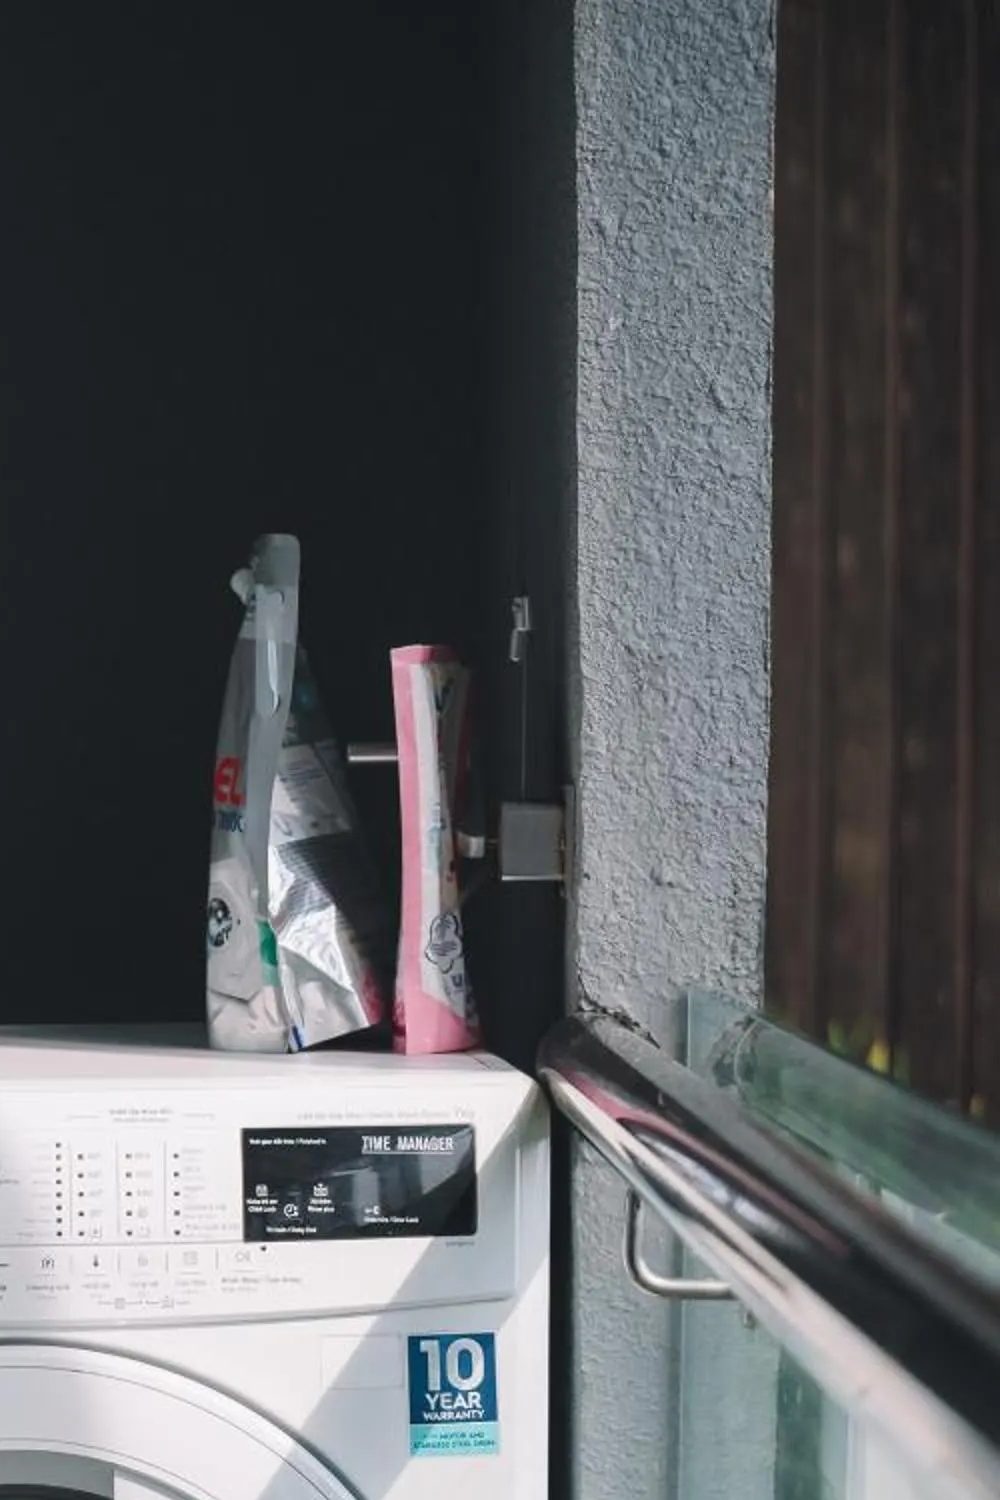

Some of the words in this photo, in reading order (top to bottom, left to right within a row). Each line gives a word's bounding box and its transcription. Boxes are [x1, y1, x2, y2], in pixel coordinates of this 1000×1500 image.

[361, 1135, 391, 1151] TIME
[397, 1135, 454, 1151] MANAGER
[420, 1338, 485, 1391] 10
[425, 1391, 482, 1410] YEAR
[422, 1409, 485, 1421] WARRANTY
